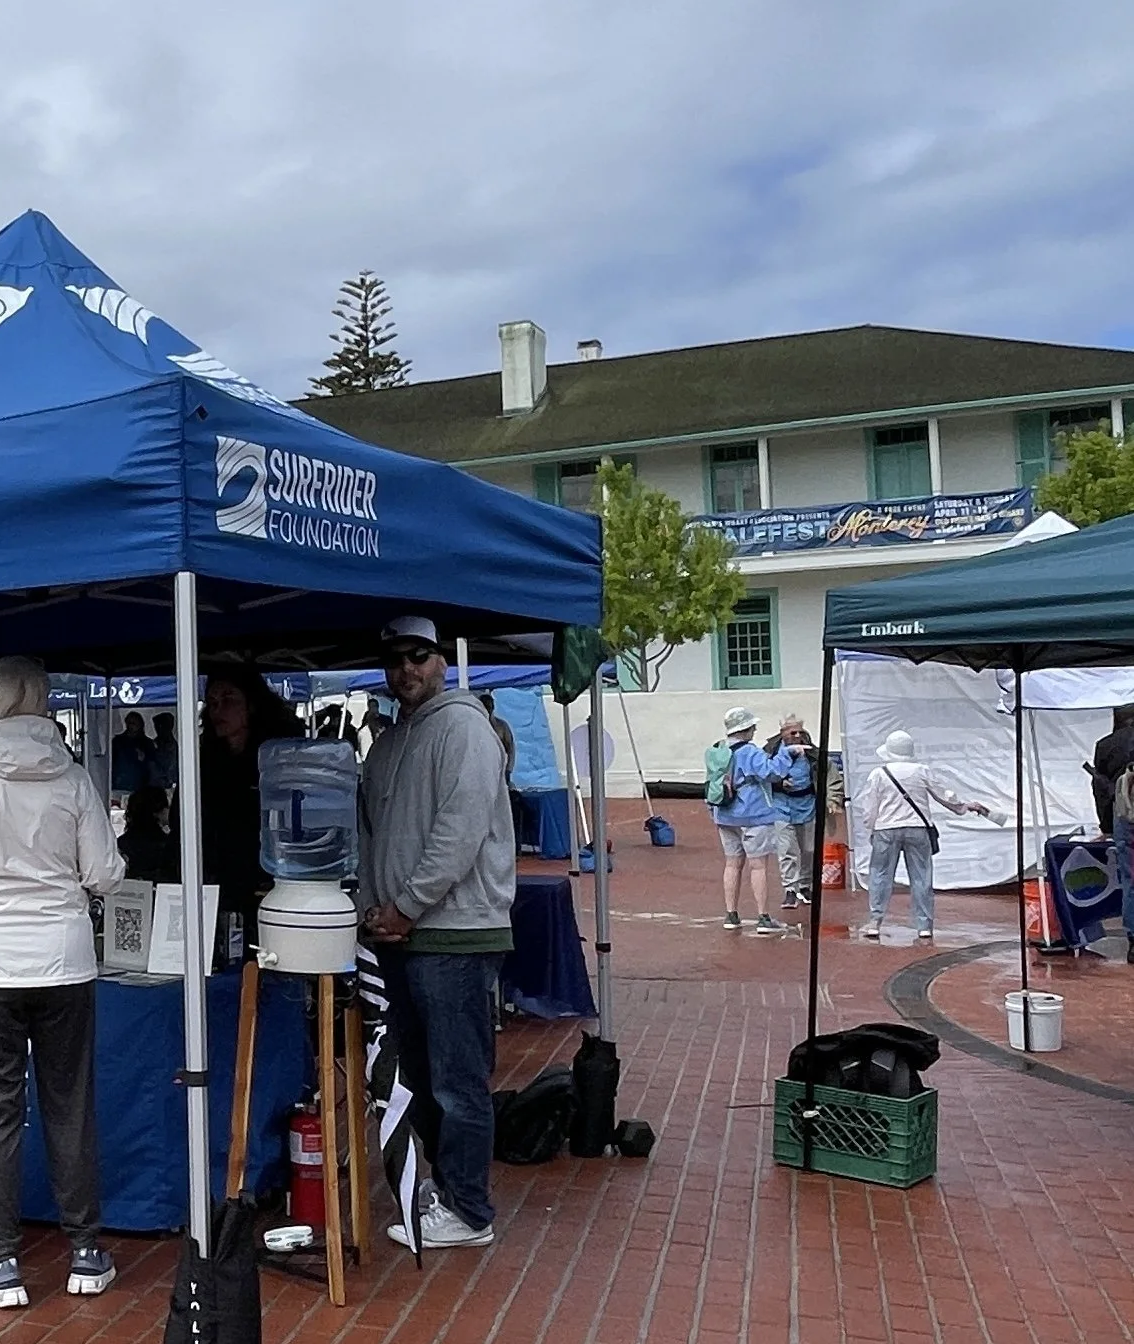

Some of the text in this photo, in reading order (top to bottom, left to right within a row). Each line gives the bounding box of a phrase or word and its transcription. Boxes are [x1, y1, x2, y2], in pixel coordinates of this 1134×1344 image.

[268, 448, 378, 521] SURFRIDER
[268, 508, 380, 558] FOUNDATION
[714, 508, 930, 545] ALEFEST Monterey
[861, 620, 925, 636] Embark
